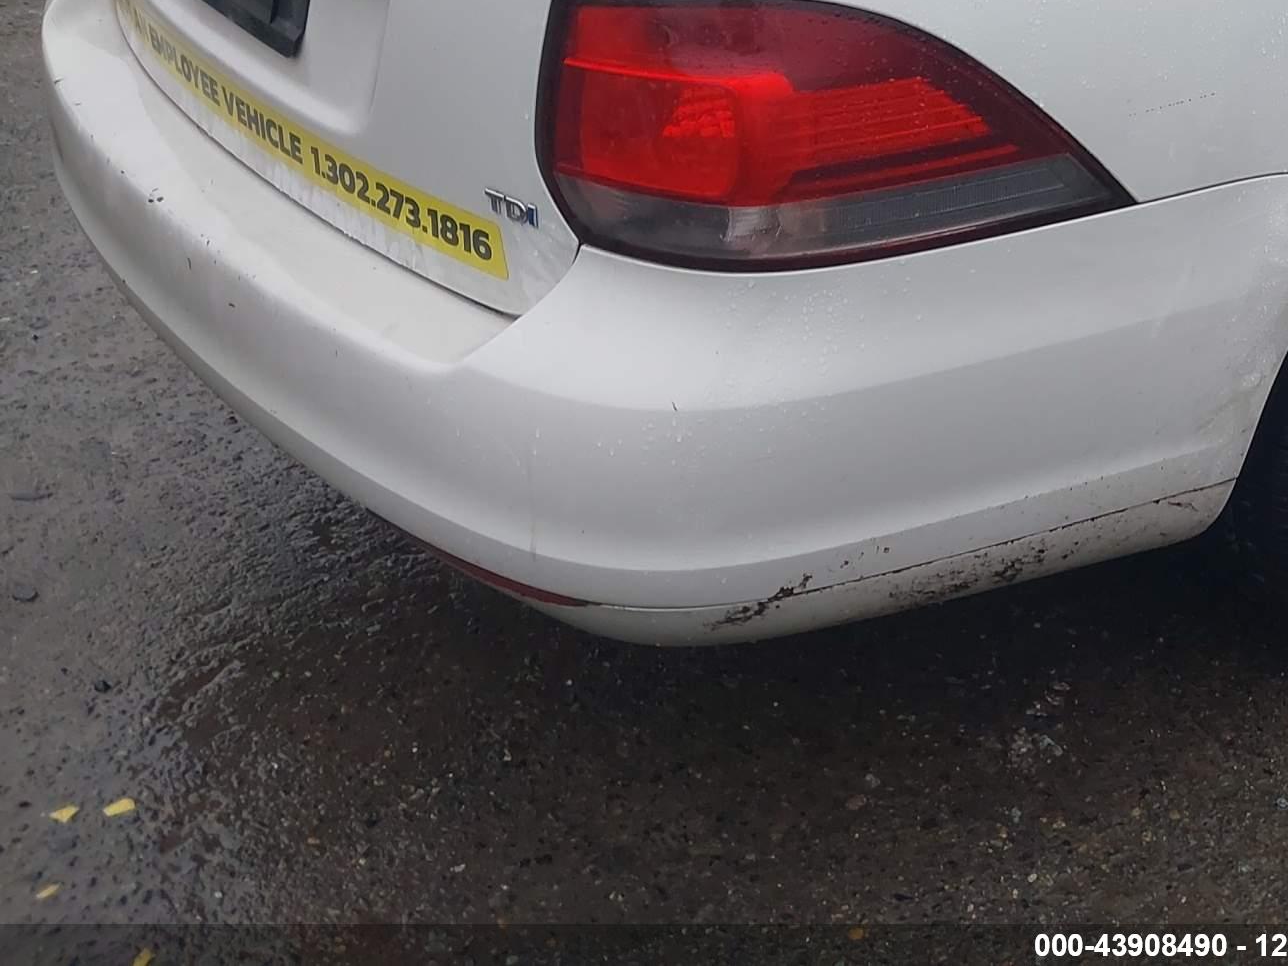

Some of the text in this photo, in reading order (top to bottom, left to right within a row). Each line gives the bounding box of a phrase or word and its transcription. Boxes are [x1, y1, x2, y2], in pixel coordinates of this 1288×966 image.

[222, 86, 304, 165] VEHICLE
[310, 146, 493, 261] 1.302.273.1816
[484, 187, 540, 229] TDI
